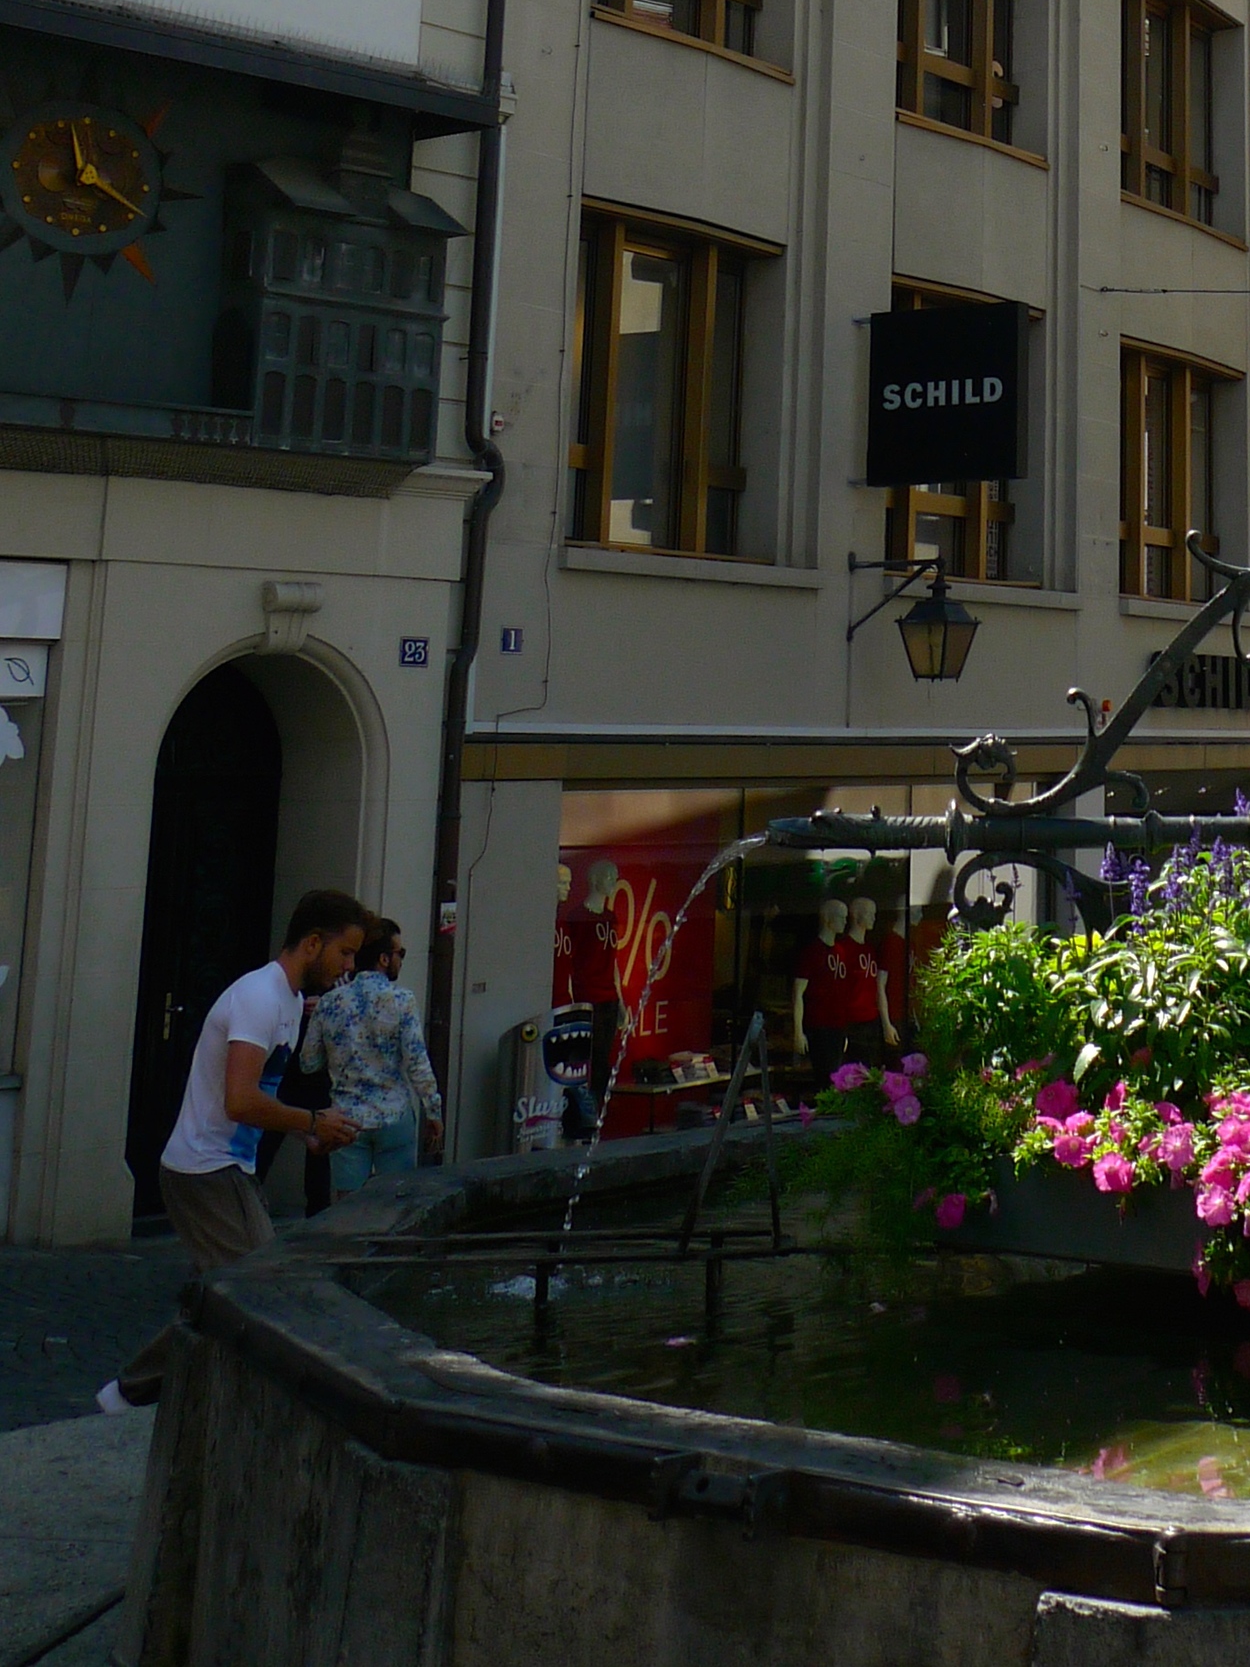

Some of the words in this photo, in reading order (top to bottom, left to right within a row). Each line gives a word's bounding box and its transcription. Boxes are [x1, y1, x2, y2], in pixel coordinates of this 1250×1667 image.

[882, 376, 1004, 411] SCHILD
[509, 630, 515, 650] 1
[404, 641, 425, 662] 23
